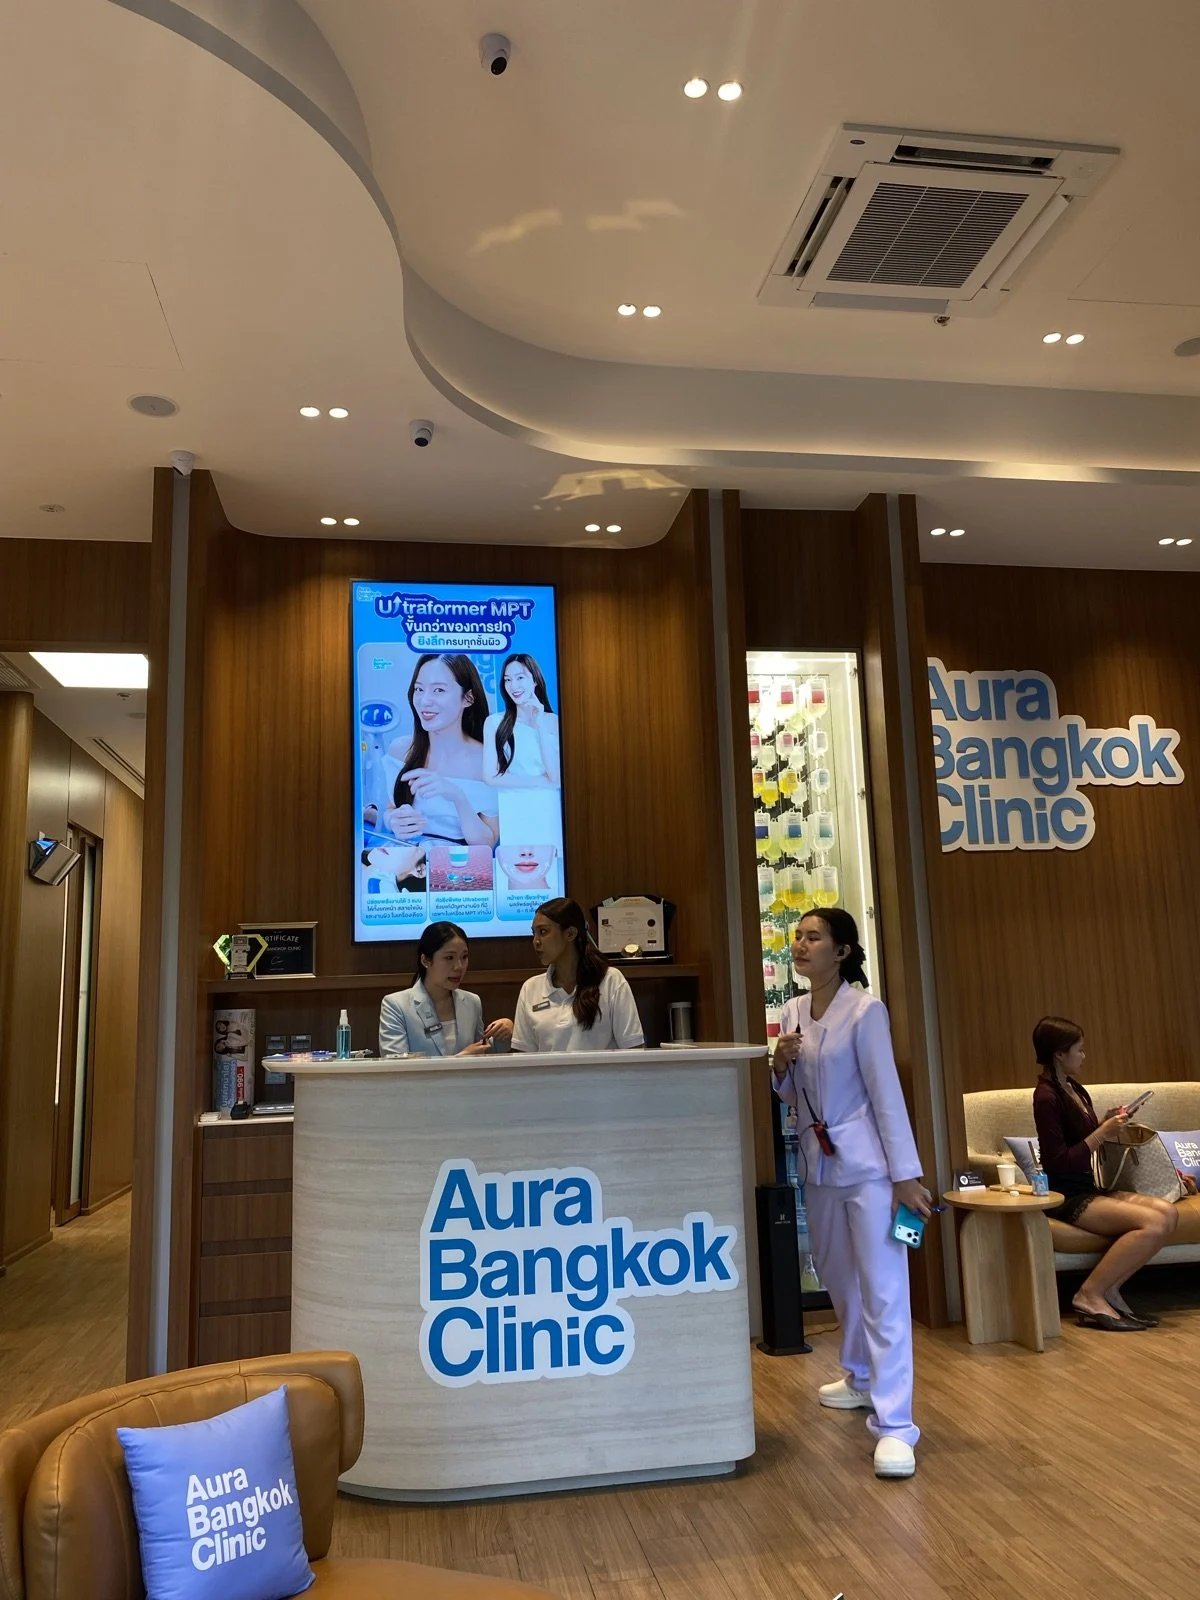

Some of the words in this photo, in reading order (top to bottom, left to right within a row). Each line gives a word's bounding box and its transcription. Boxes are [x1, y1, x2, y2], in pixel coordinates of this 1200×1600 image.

[490, 602, 531, 617] MPT
[927, 665, 1051, 722] Aura
[932, 723, 1177, 797] Bangkok
[937, 783, 1088, 846] Clinic
[264, 935, 300, 943] RTIFICATE
[1174, 1140, 1199, 1150] Aura
[429, 1168, 593, 1233] Aura
[428, 1221, 731, 1312] Bangkok
[428, 1304, 626, 1377] Clinic
[186, 1467, 249, 1506] Aura
[186, 1478, 294, 1539] Bangkok
[191, 1526, 267, 1571] Clinic
